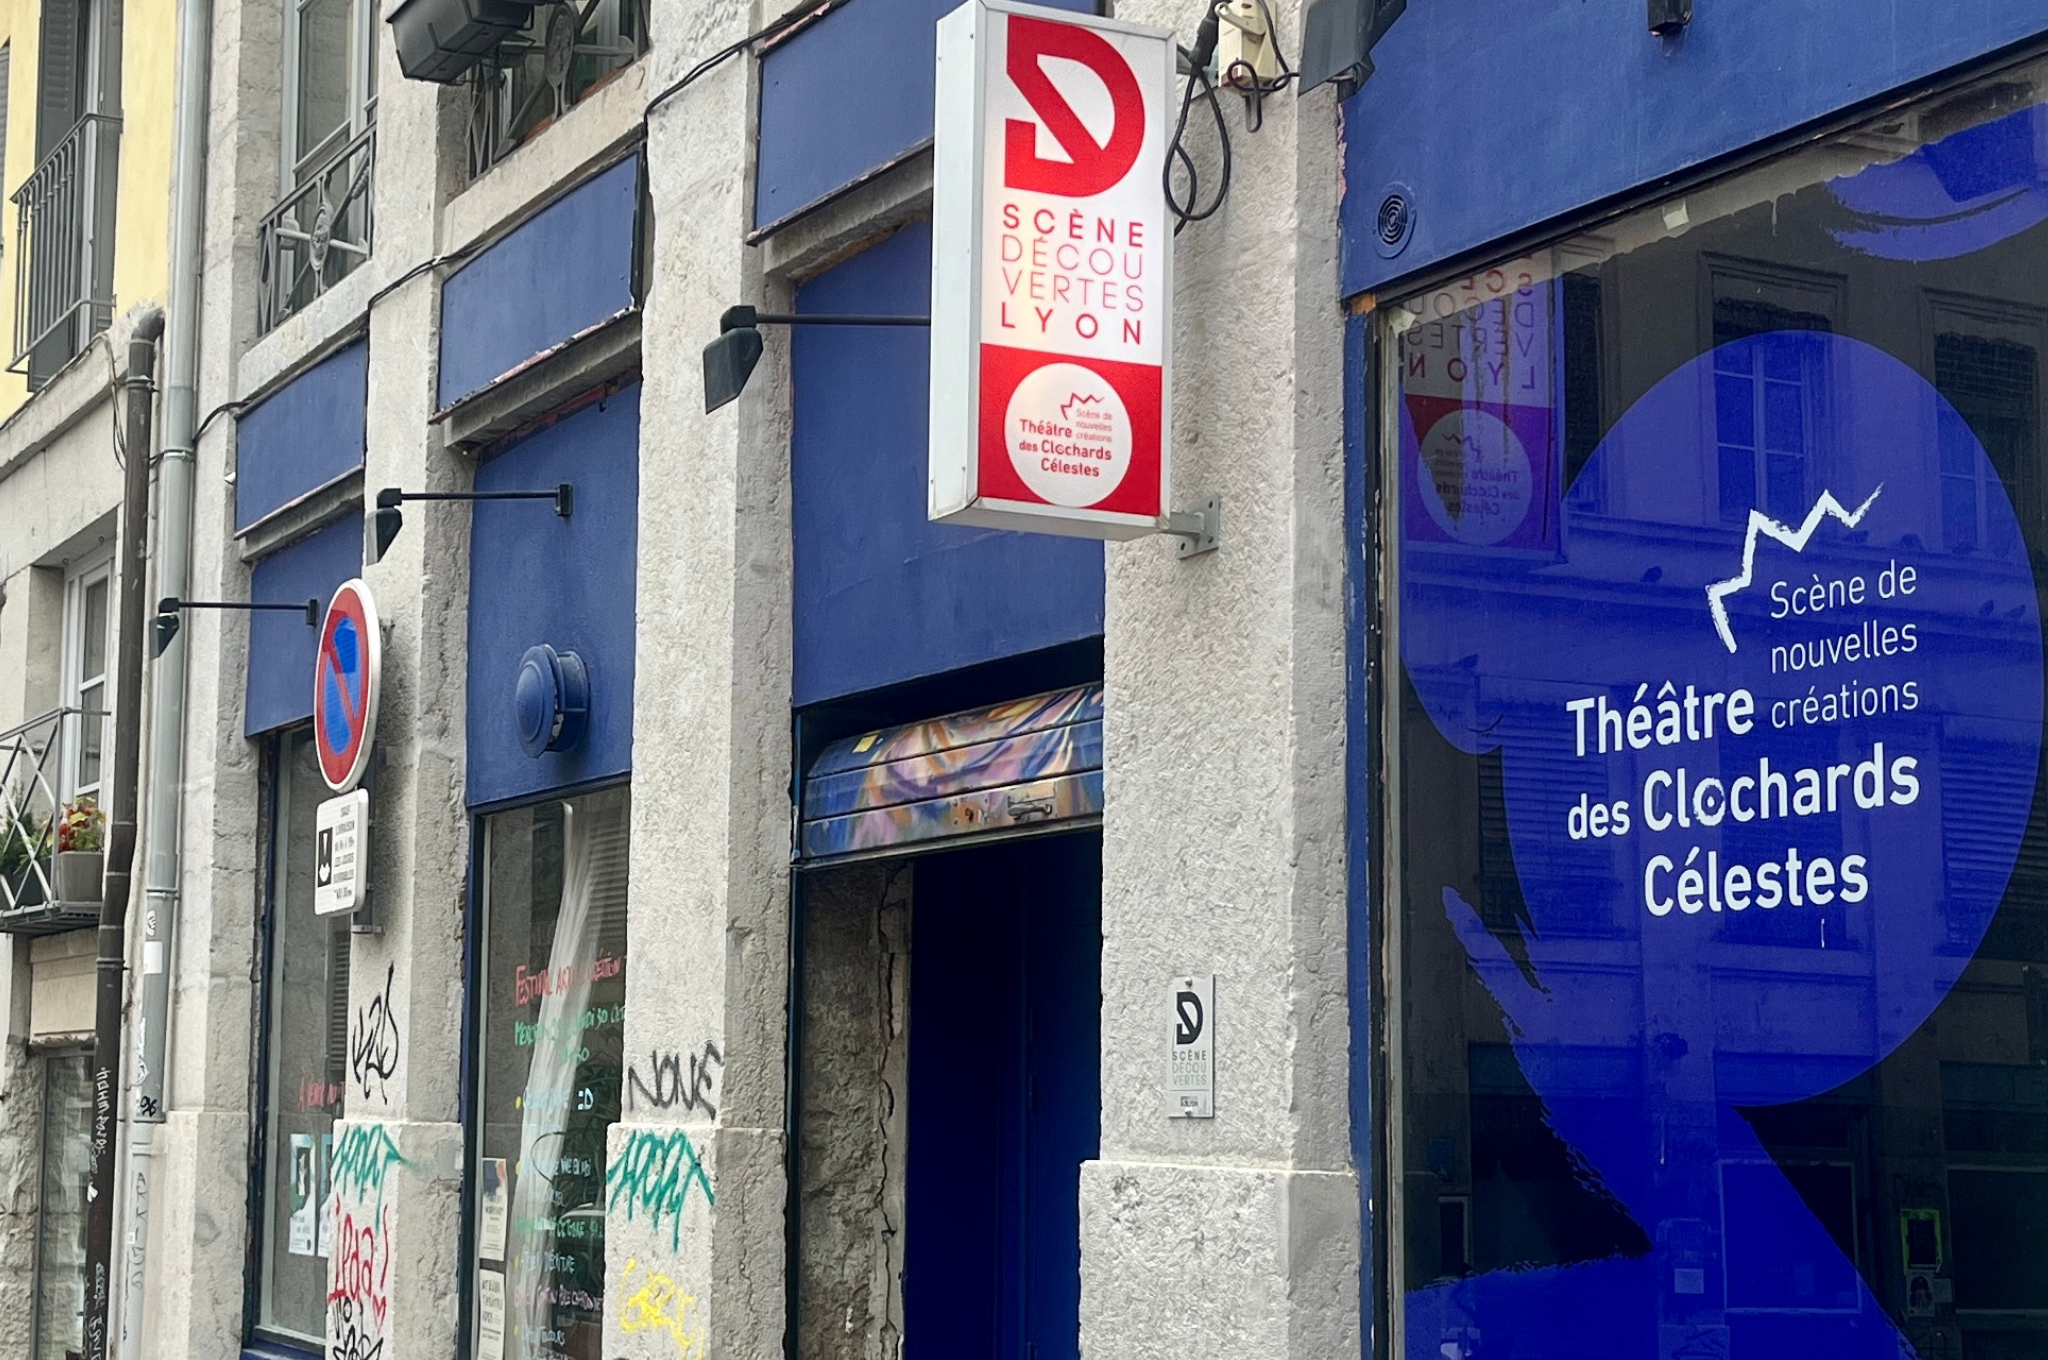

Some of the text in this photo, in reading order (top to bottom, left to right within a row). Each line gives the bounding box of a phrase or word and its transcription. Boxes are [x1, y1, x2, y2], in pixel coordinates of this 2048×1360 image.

[1002, 203, 1144, 248] SCÈNE
[1001, 234, 1143, 280] DÉCOU
[1001, 266, 1144, 312] VERTES
[1001, 301, 1141, 346] LYON
[1019, 418, 1073, 438] Théâtre
[1019, 439, 1112, 461] des Clochards
[1041, 457, 1100, 477] Célestes
[1769, 558, 1917, 619] Scène de
[1770, 620, 1918, 674] nouvelles
[1565, 678, 1756, 758] Théâtre
[1770, 679, 1920, 730] créations
[1567, 741, 1921, 841] des Clochards
[1644, 845, 1870, 917] Célestes
[1171, 1049, 1207, 1062] SCÈNE
[1172, 1073, 1208, 1086] VERTES
